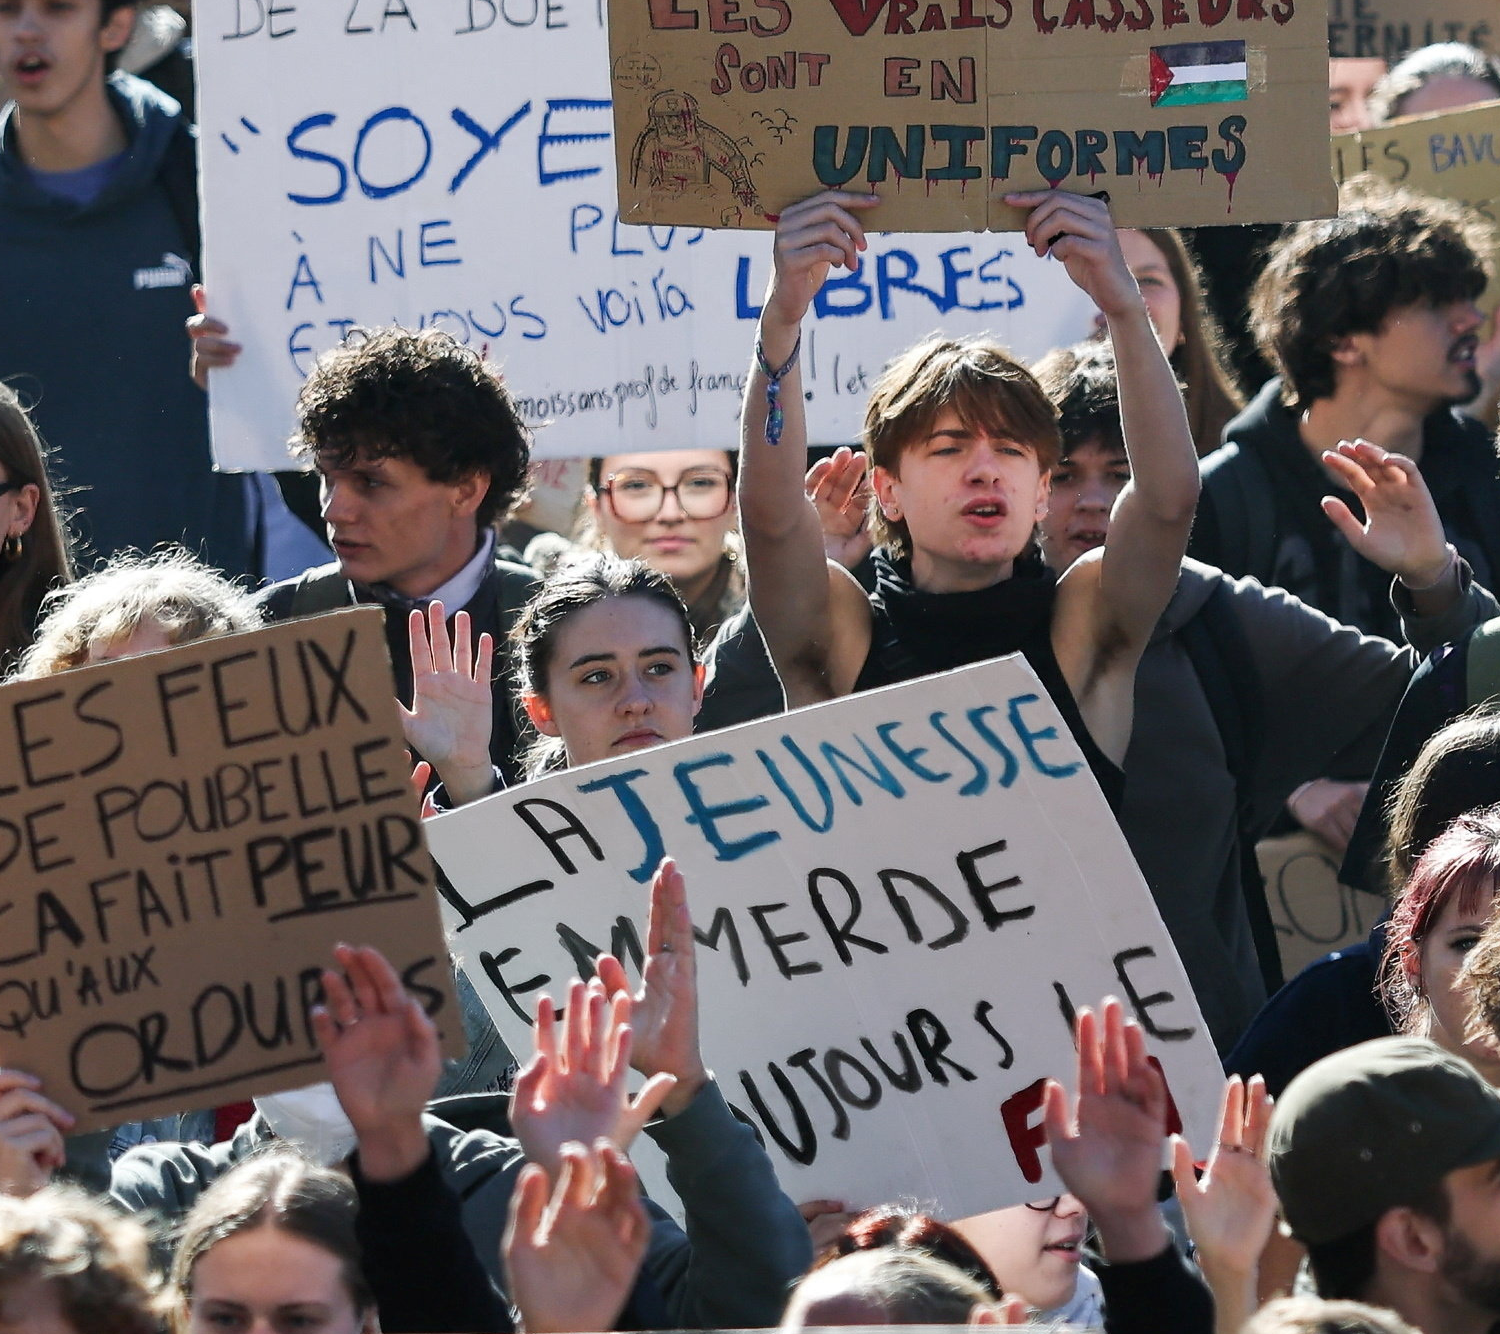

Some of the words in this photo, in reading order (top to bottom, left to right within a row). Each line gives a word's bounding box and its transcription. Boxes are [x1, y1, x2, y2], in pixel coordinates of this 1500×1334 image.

[708, 42, 831, 98] SONT
[882, 55, 978, 105] EN
[811, 115, 1249, 187] UNIFORMES
[288, 231, 325, 312] À
[367, 217, 466, 287] NE
[156, 628, 370, 759] FEUX
[98, 738, 408, 861] POUBELLE
[427, 795, 605, 933] LA
[577, 692, 1084, 886] JEUNESSE
[249, 816, 429, 912] PEUR
